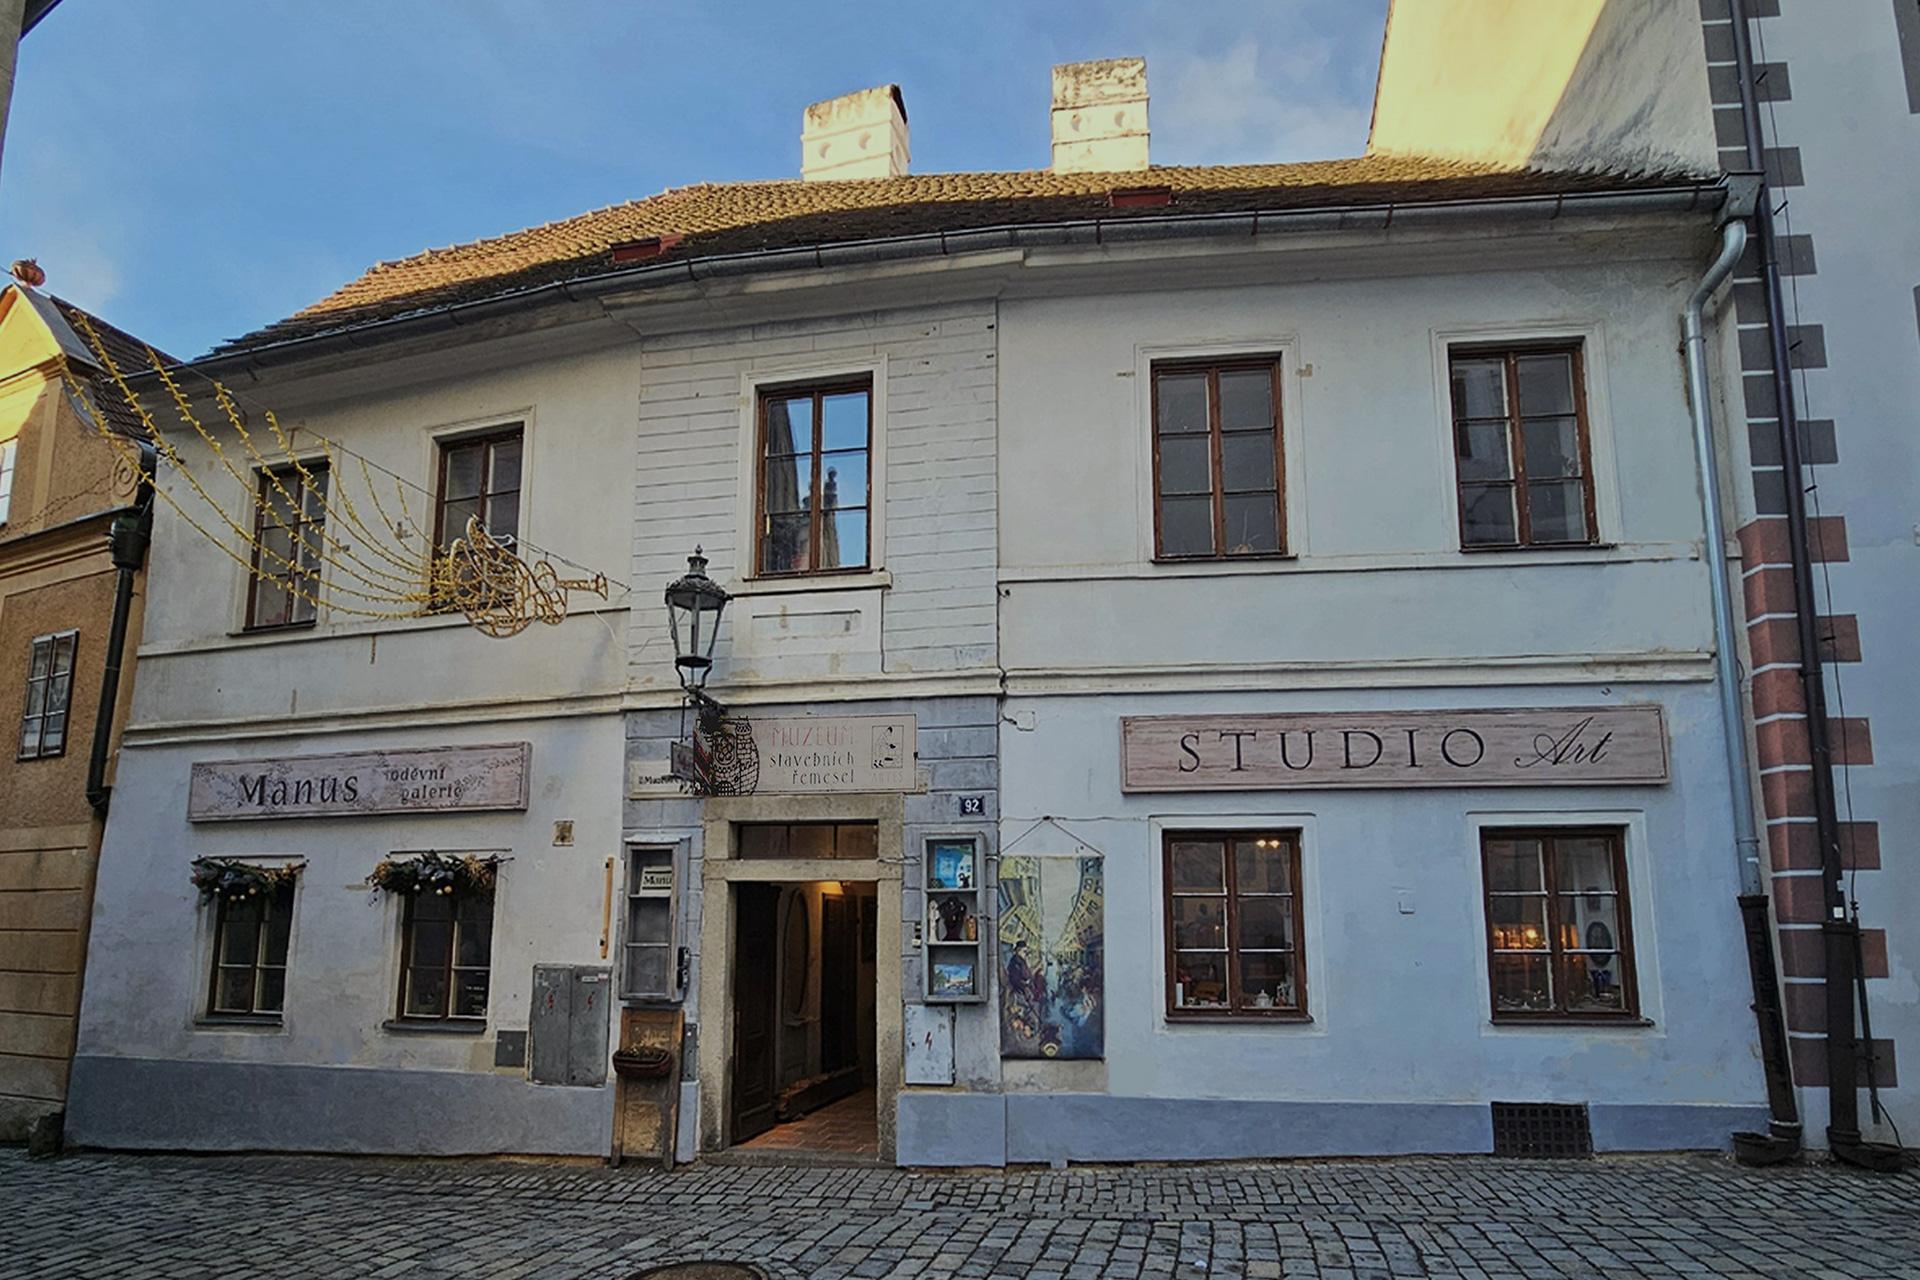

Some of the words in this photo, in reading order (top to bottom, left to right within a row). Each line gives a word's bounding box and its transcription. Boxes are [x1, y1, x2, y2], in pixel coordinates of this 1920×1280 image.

[771, 725, 854, 747] MUZEUM
[1178, 728, 1485, 773] STUDIO
[1514, 716, 1614, 767] Art
[769, 751, 855, 768] stavebních
[792, 769, 854, 785] řemesel
[237, 774, 358, 808] Manus
[401, 781, 463, 805] galerie
[964, 799, 980, 813] 92
